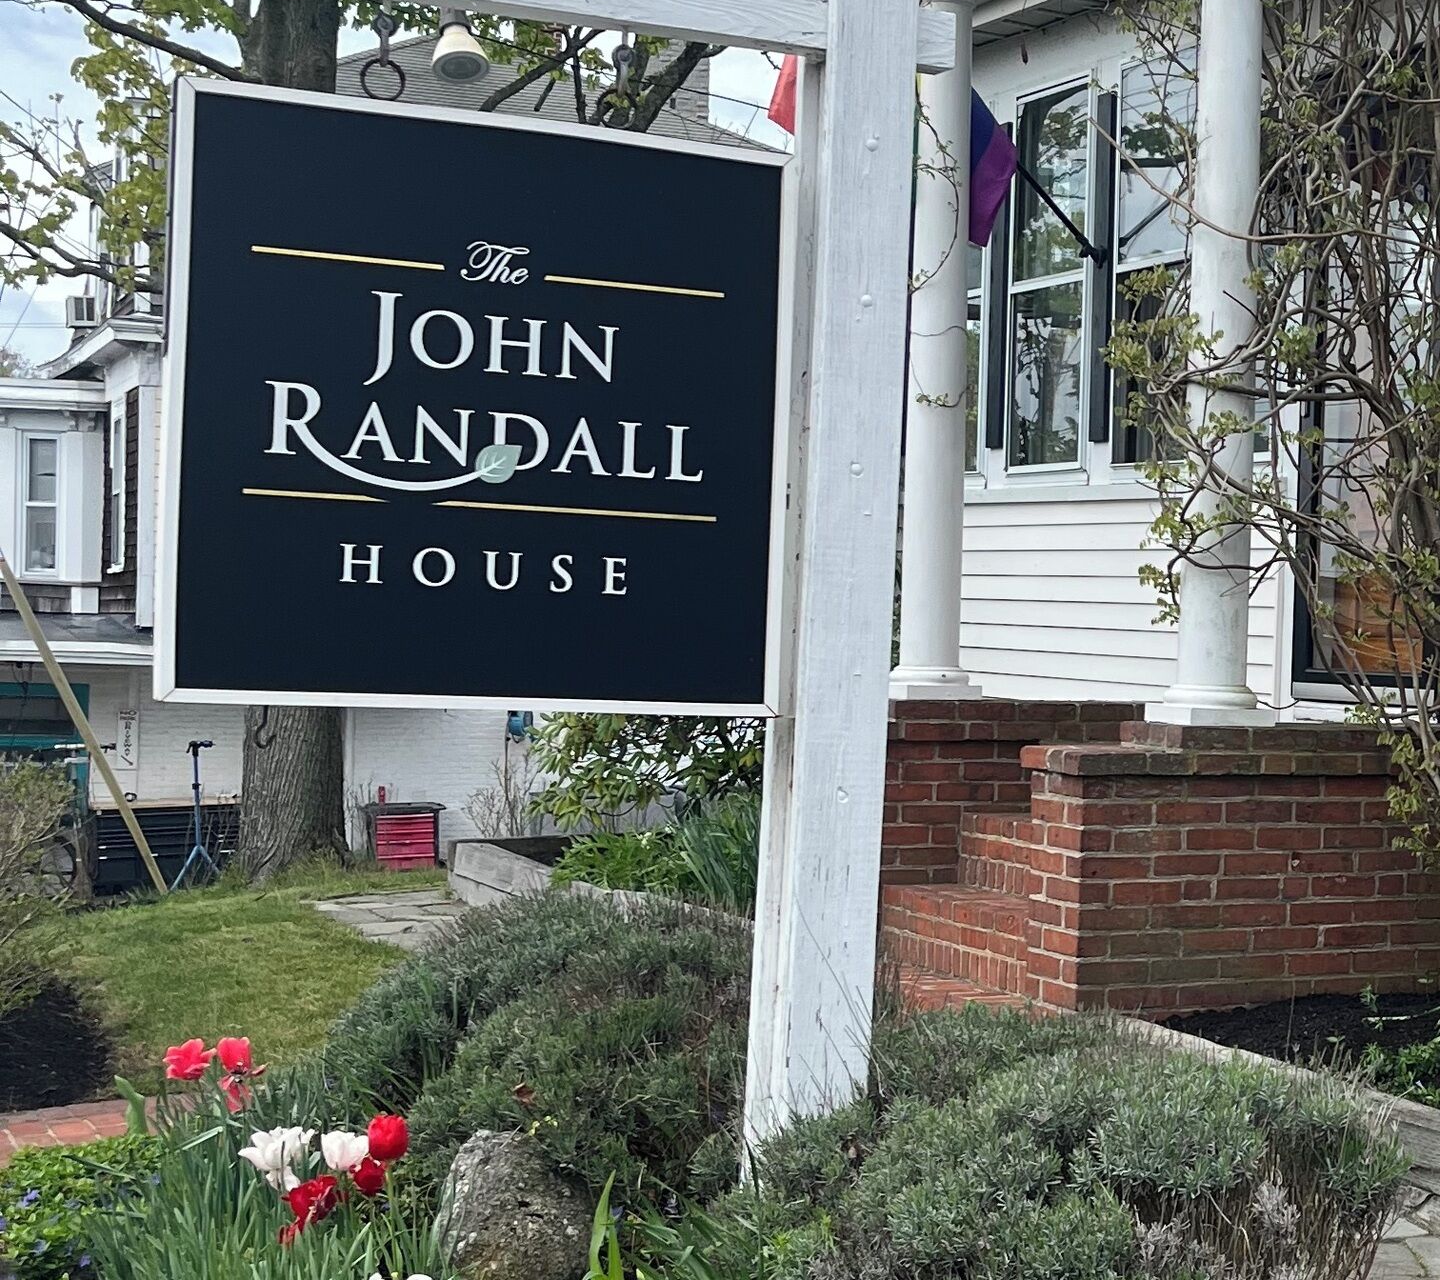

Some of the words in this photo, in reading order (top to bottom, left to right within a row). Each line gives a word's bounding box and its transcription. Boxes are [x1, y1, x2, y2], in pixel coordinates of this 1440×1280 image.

[460, 240, 530, 285] The
[363, 290, 620, 386] JOHN
[263, 380, 704, 491] RANDALL
[339, 543, 627, 596] HOUSE
